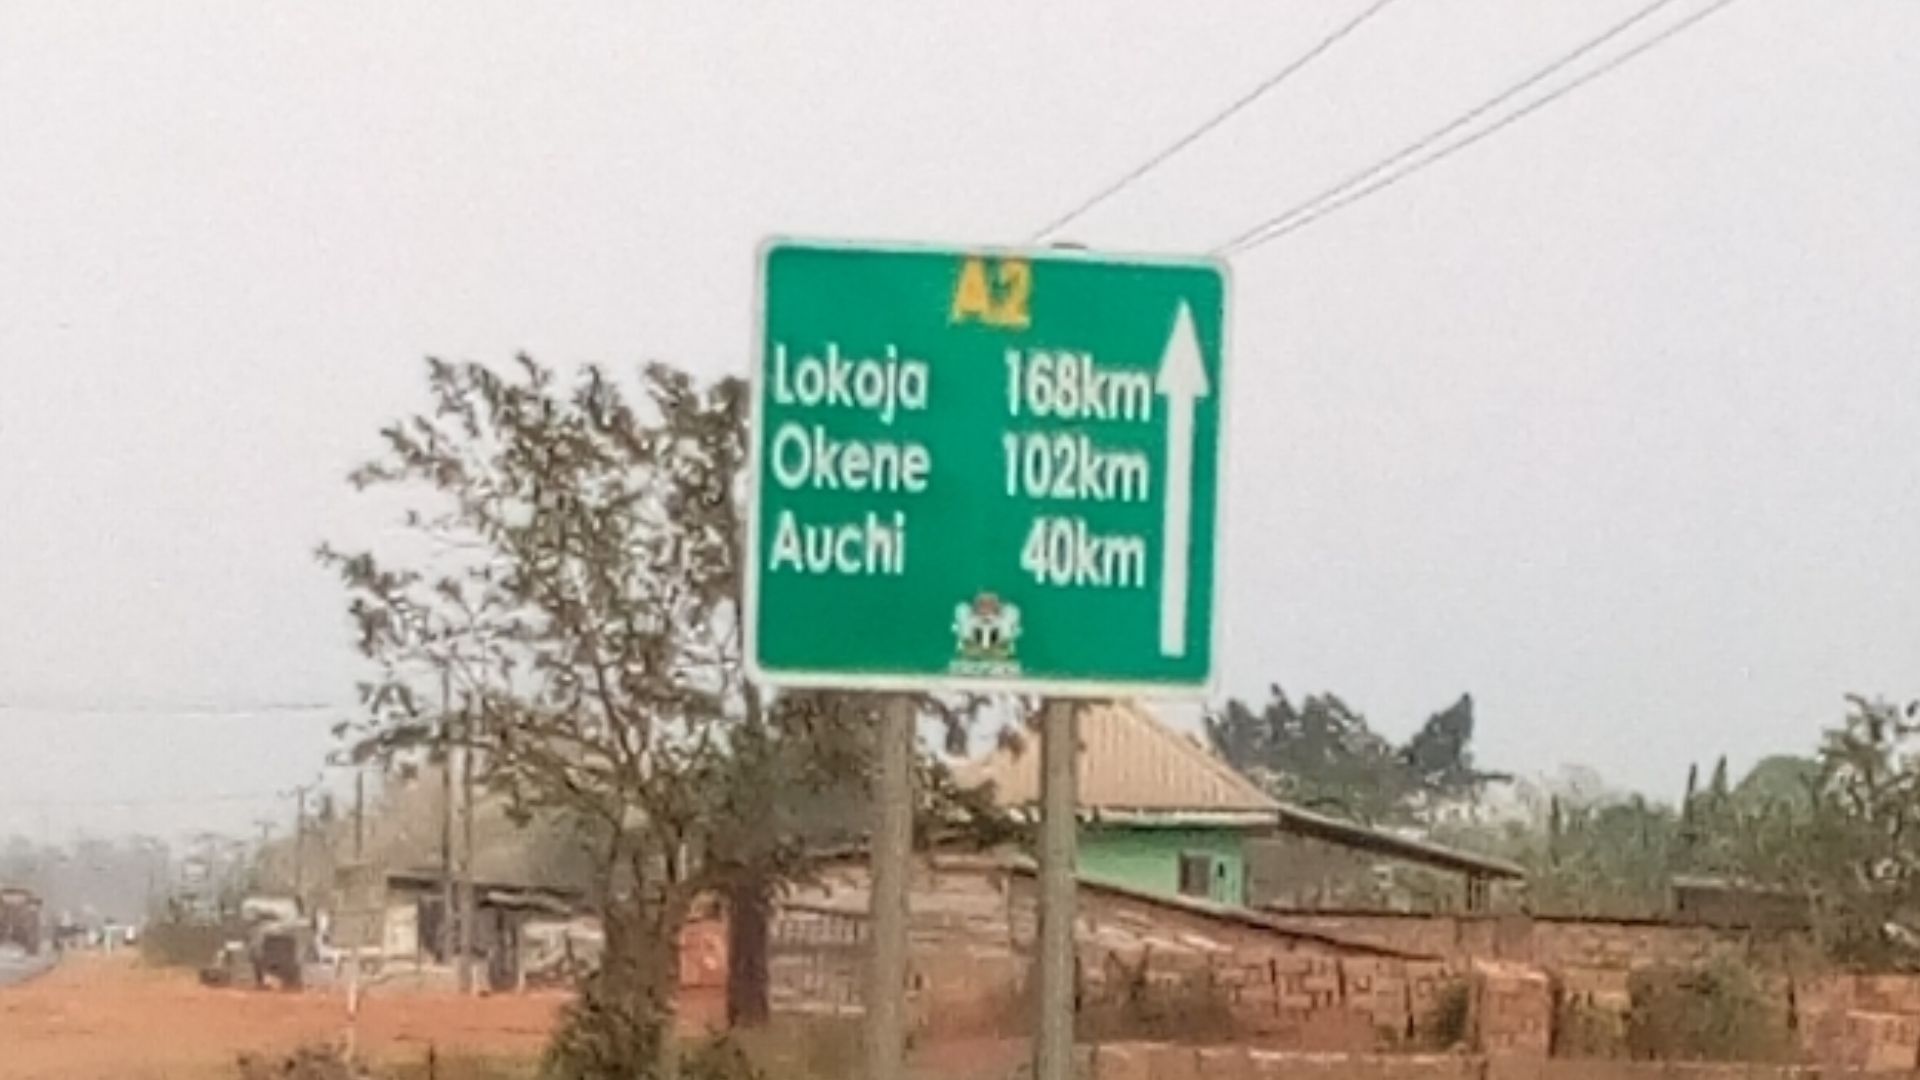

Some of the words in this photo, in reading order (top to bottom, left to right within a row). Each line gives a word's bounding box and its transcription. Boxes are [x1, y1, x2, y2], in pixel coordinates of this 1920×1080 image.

[952, 256, 1031, 328] A2
[773, 344, 929, 423] Lokoja
[1005, 350, 1151, 421] 168km
[772, 424, 930, 491] Okene
[1003, 433, 1148, 501] 102km
[770, 511, 905, 574] Auchi
[1020, 517, 1145, 587] 40km
